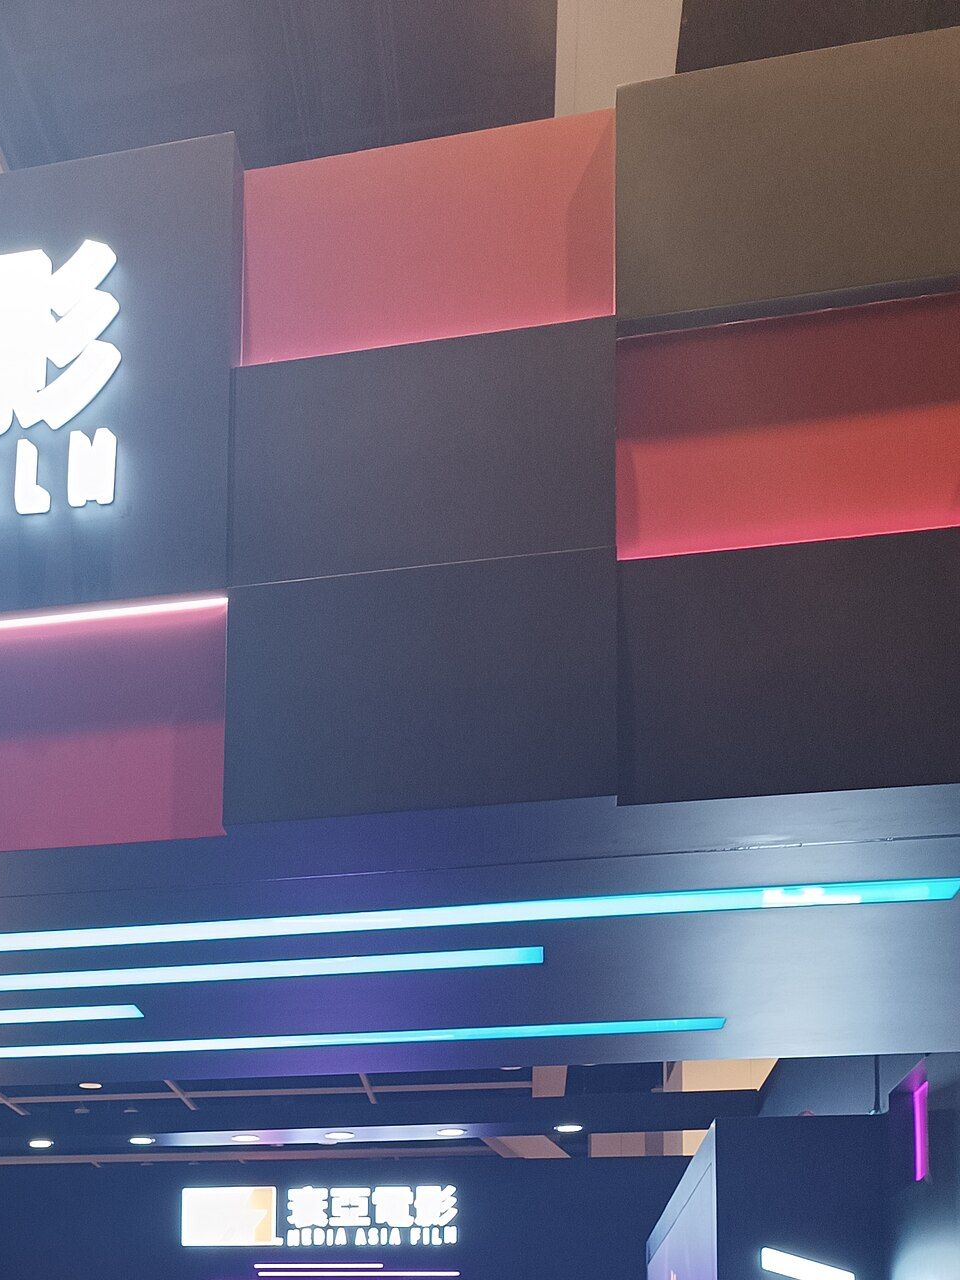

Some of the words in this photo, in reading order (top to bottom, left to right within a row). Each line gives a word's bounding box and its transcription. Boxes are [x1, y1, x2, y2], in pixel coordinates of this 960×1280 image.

[287, 1227, 347, 1247] MEDIA
[354, 1226, 401, 1246] ASIA
[410, 1225, 458, 1246] FILM
